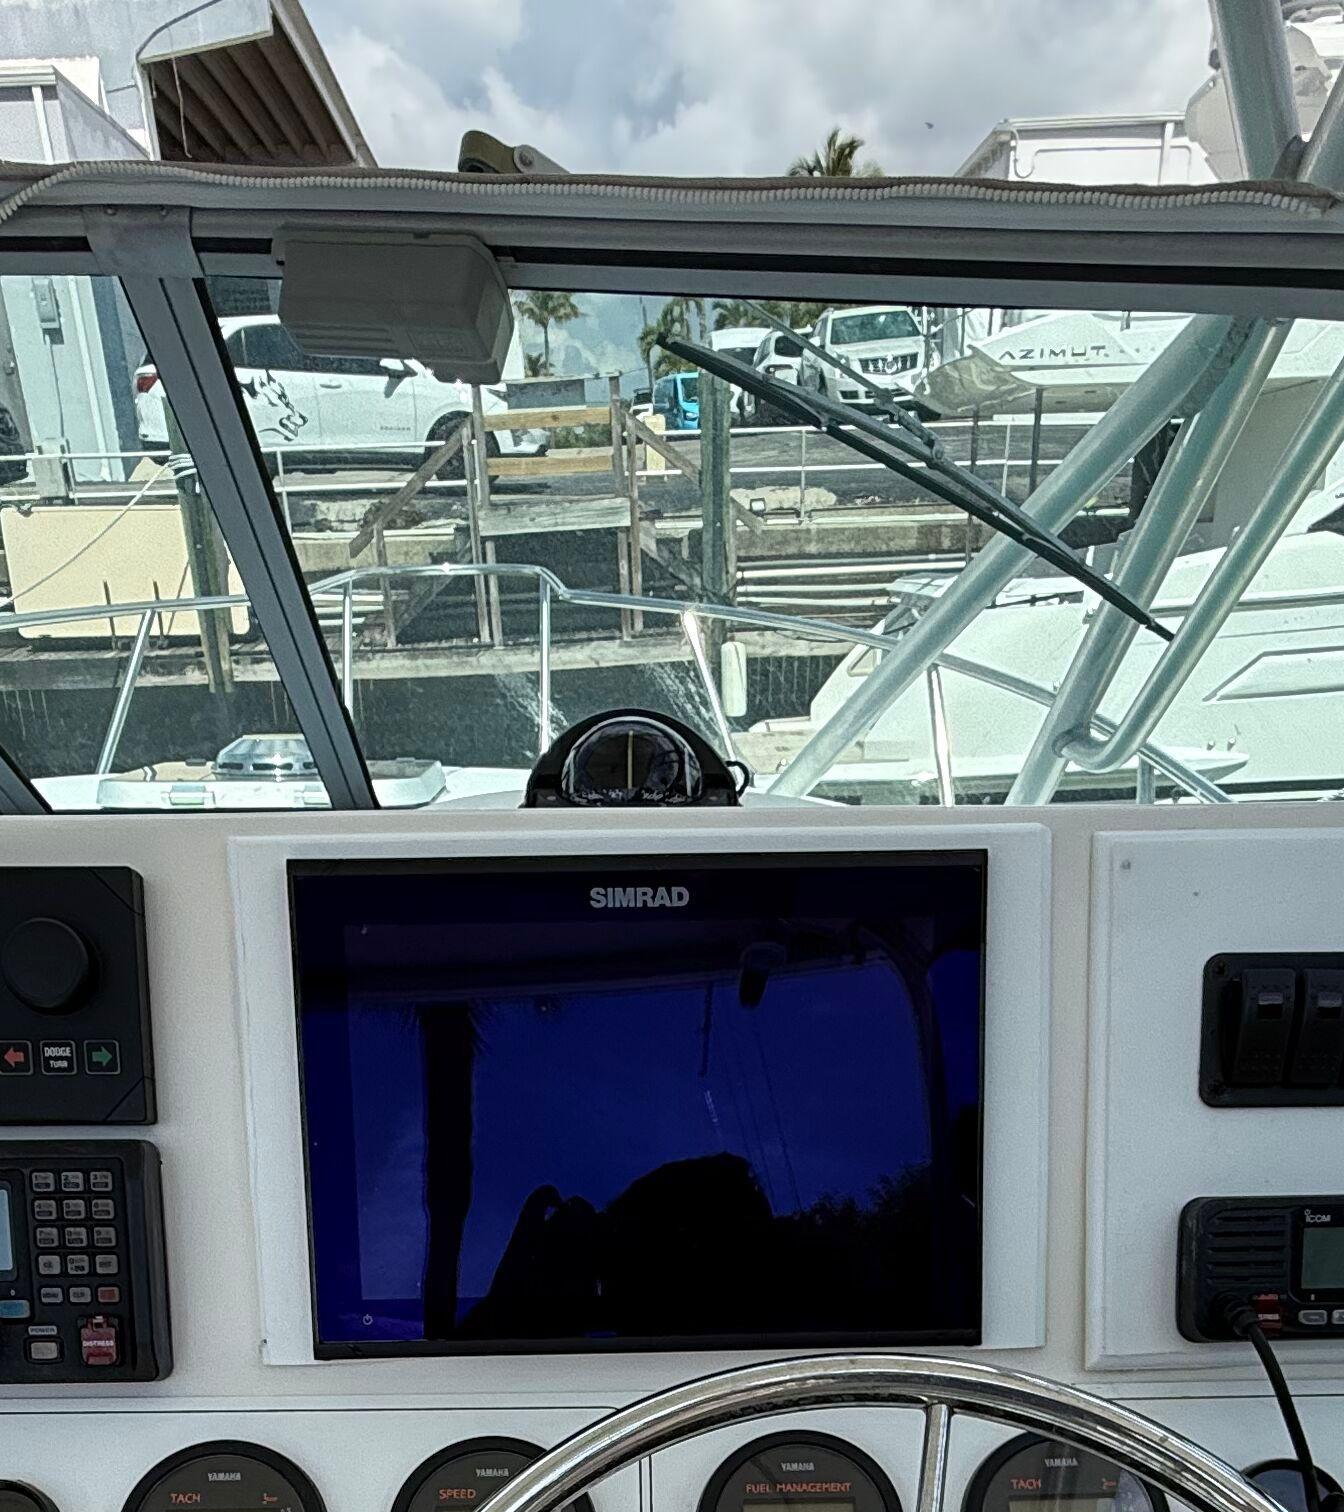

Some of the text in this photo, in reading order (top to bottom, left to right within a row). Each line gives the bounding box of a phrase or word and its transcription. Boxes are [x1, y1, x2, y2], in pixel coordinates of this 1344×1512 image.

[999, 345, 1106, 360] AZIMUT
[588, 886, 690, 909] SIMRAD
[44, 1047, 72, 1057] DODGE
[780, 1462, 815, 1472] YAMAHA
[1044, 1457, 1079, 1467] YAMAHA
[475, 1468, 510, 1478] YAMAHA
[745, 1482, 852, 1494] FUEL MANAGEMENT
[1010, 1478, 1042, 1490] TACH
[169, 1492, 202, 1504] TACH
[439, 1488, 477, 1501] SPEED
